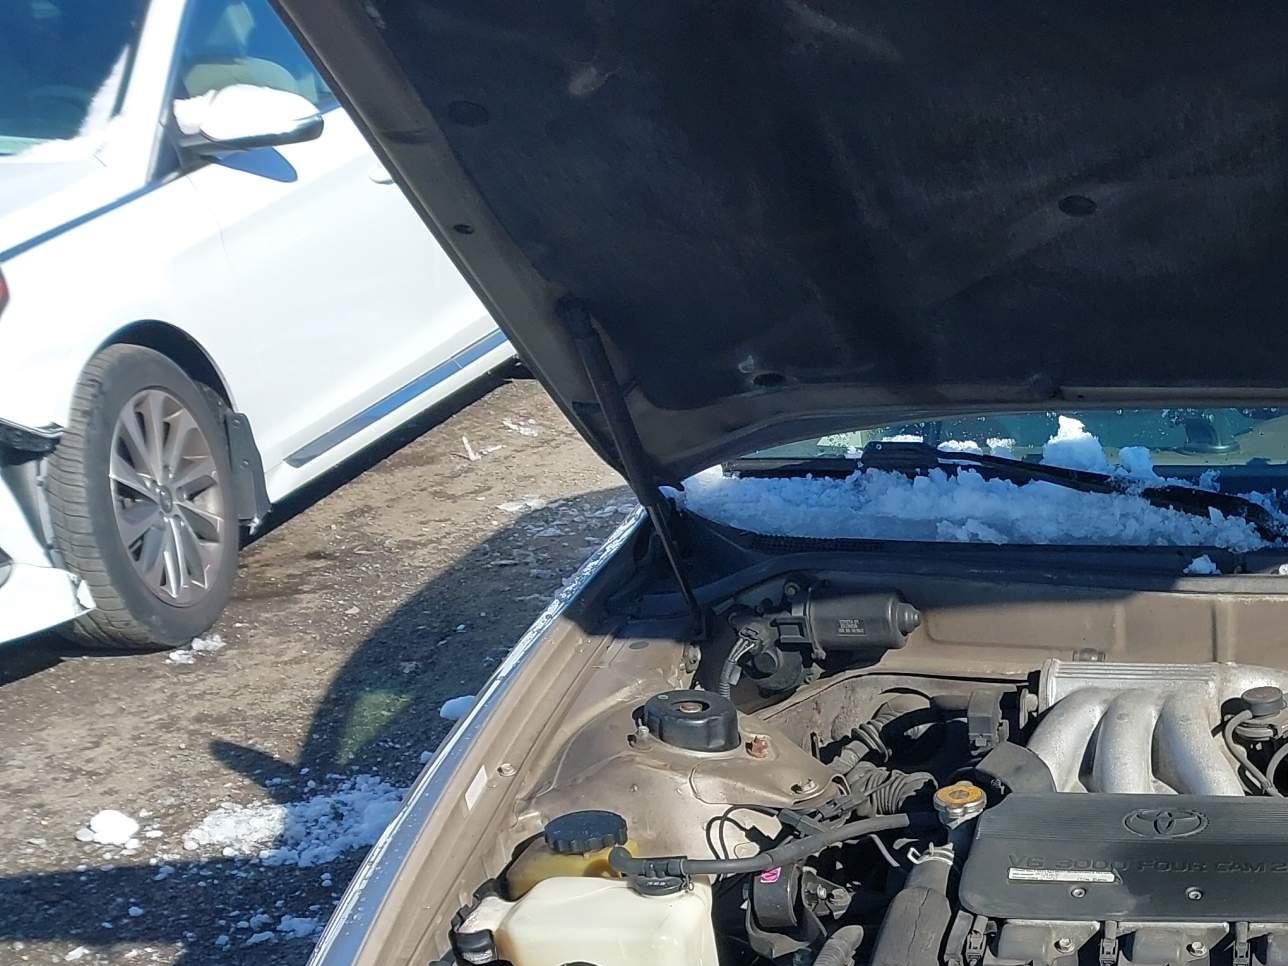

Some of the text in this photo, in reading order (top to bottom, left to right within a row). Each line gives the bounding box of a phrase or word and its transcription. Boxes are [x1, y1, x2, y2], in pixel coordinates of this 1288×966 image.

[1008, 855, 1044, 870] V6
[1137, 860, 1208, 873] FOUR
[1214, 861, 1266, 873] CAM
